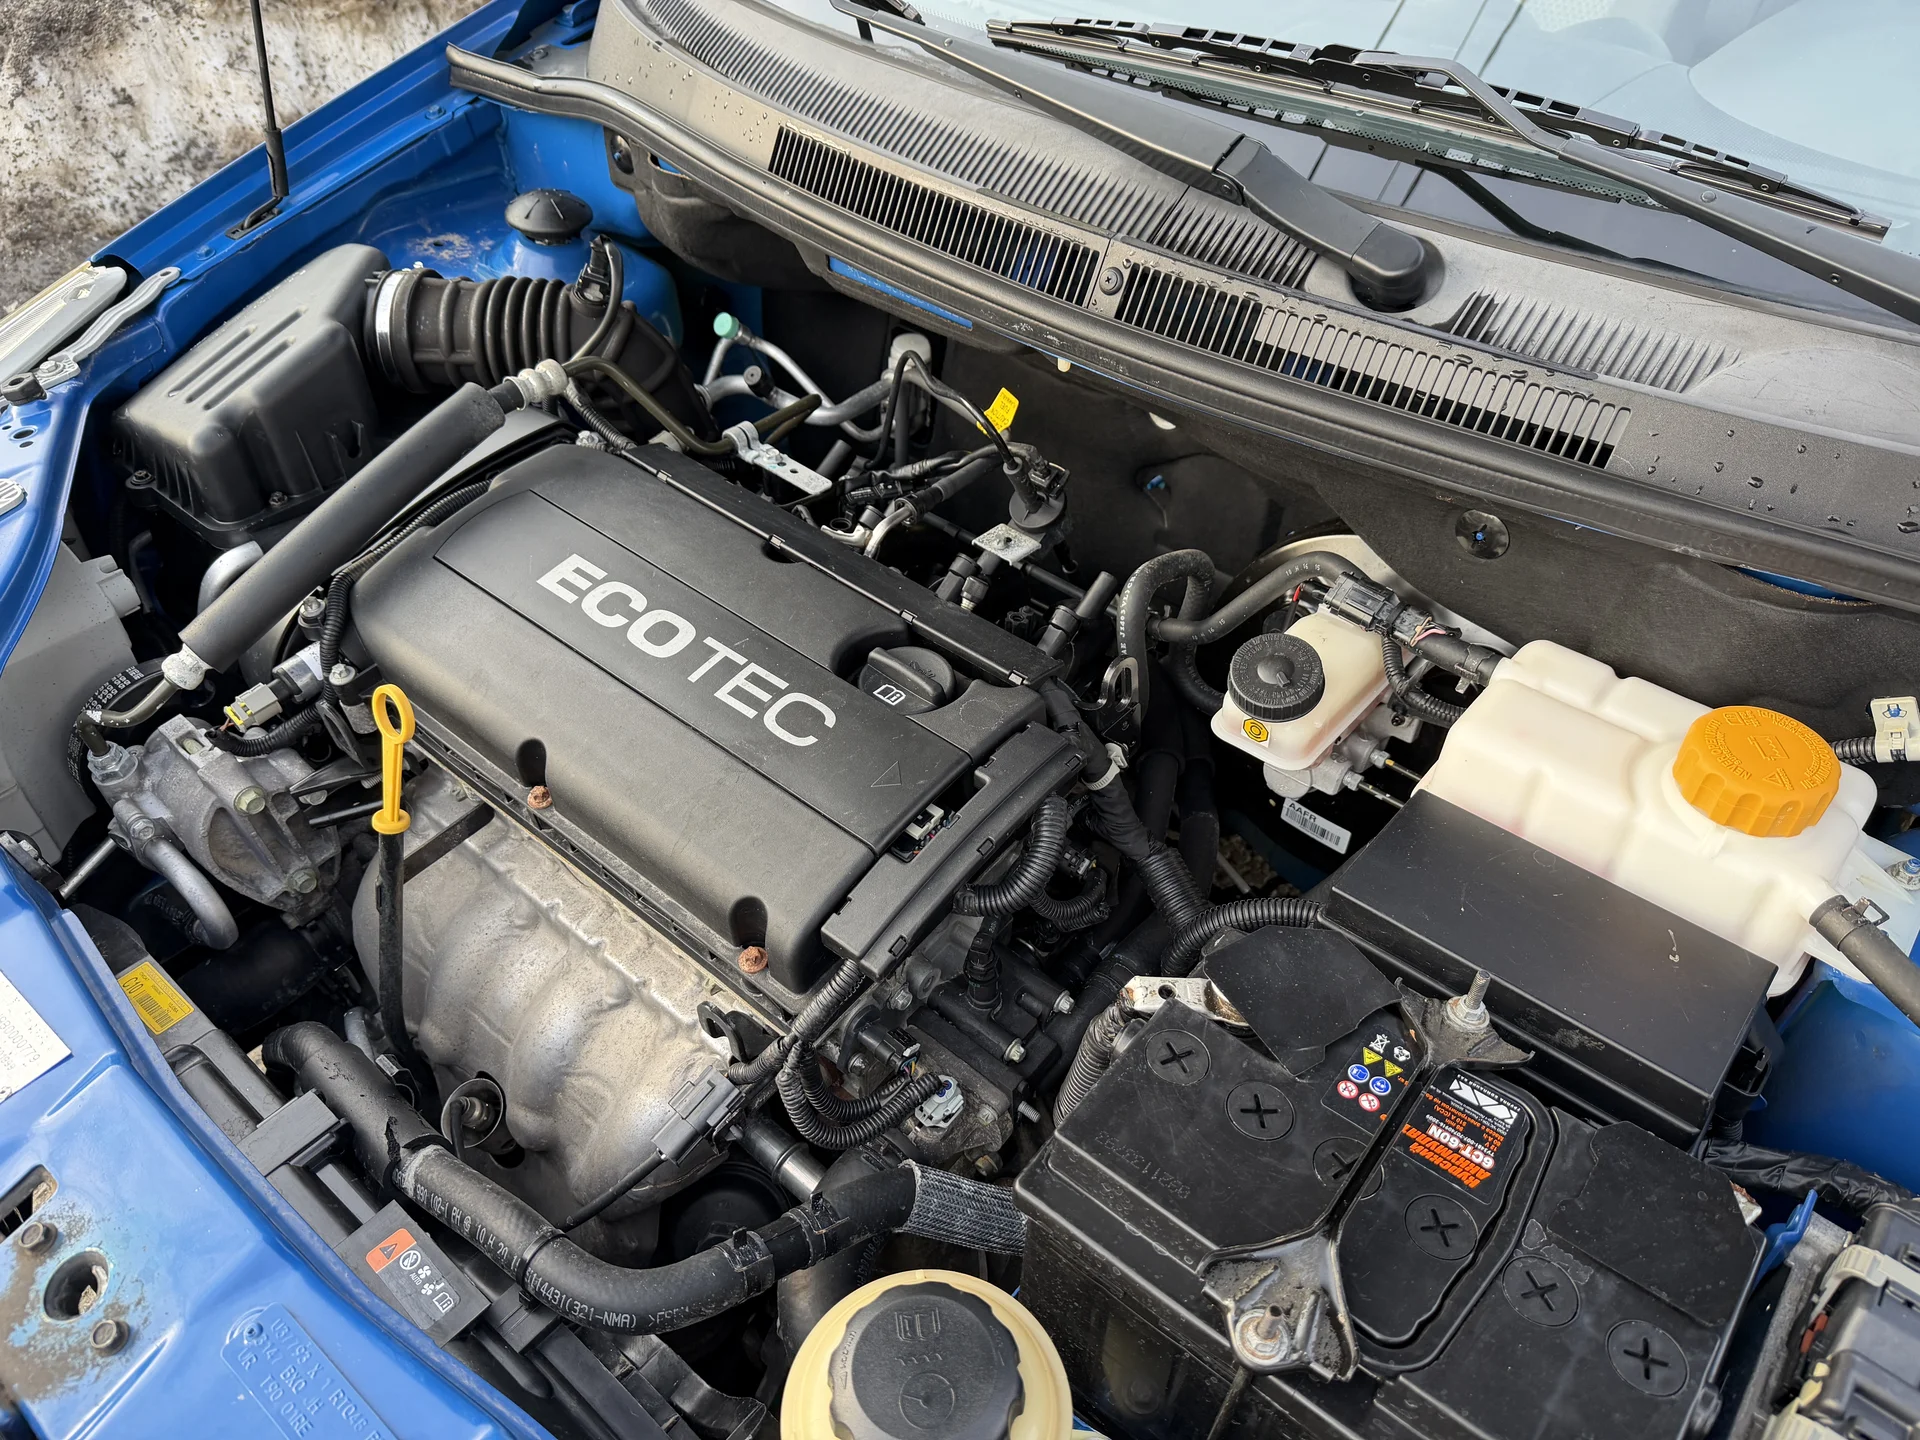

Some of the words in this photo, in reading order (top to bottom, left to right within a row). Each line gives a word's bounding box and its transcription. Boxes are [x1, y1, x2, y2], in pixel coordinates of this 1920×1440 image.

[998, 400, 1011, 414] FUEL
[537, 554, 837, 748] ECOTEC
[95, 683, 114, 700] 564
[100, 687, 119, 704] 564
[1705, 735, 1722, 755] OPEN
[1716, 755, 1752, 780] NEVER
[1287, 801, 1318, 822] AAFR
[123, 977, 144, 994] C10
[1433, 1105, 1451, 1118] (CCA)
[1409, 1141, 1480, 1189] Курский
[430, 1194, 449, 1217] 102-1
[409, 1272, 423, 1287] AUTO
[238, 1347, 258, 1371] UR
[260, 1374, 284, 1402] T90
